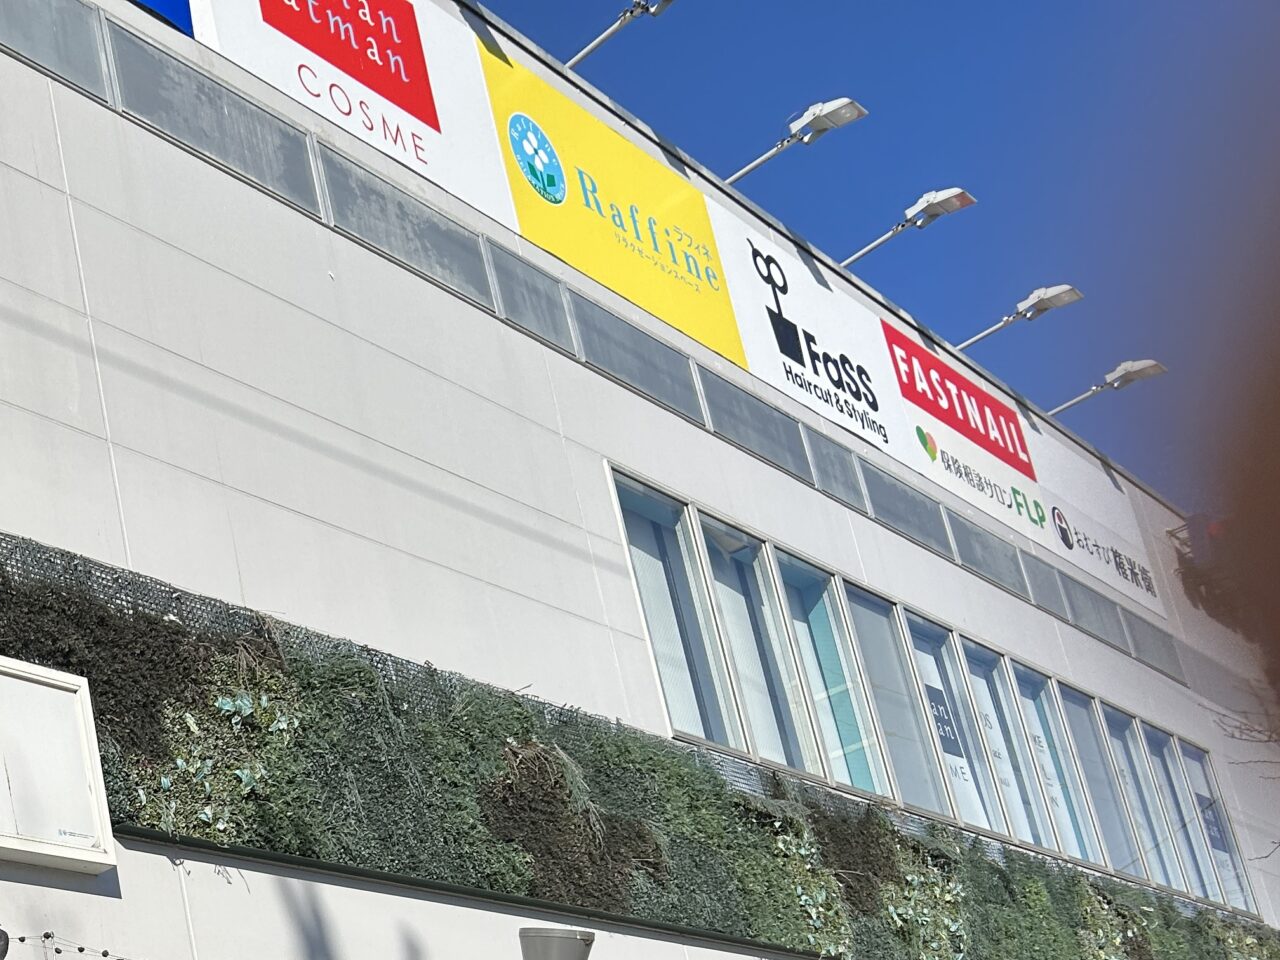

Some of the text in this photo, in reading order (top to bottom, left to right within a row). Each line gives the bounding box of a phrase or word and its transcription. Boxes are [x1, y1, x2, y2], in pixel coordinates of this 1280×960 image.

[297, 63, 429, 166] COSME
[574, 165, 720, 292] Raffine
[671, 224, 714, 264] ラフィネ
[891, 343, 1031, 464] FASTNAIL
